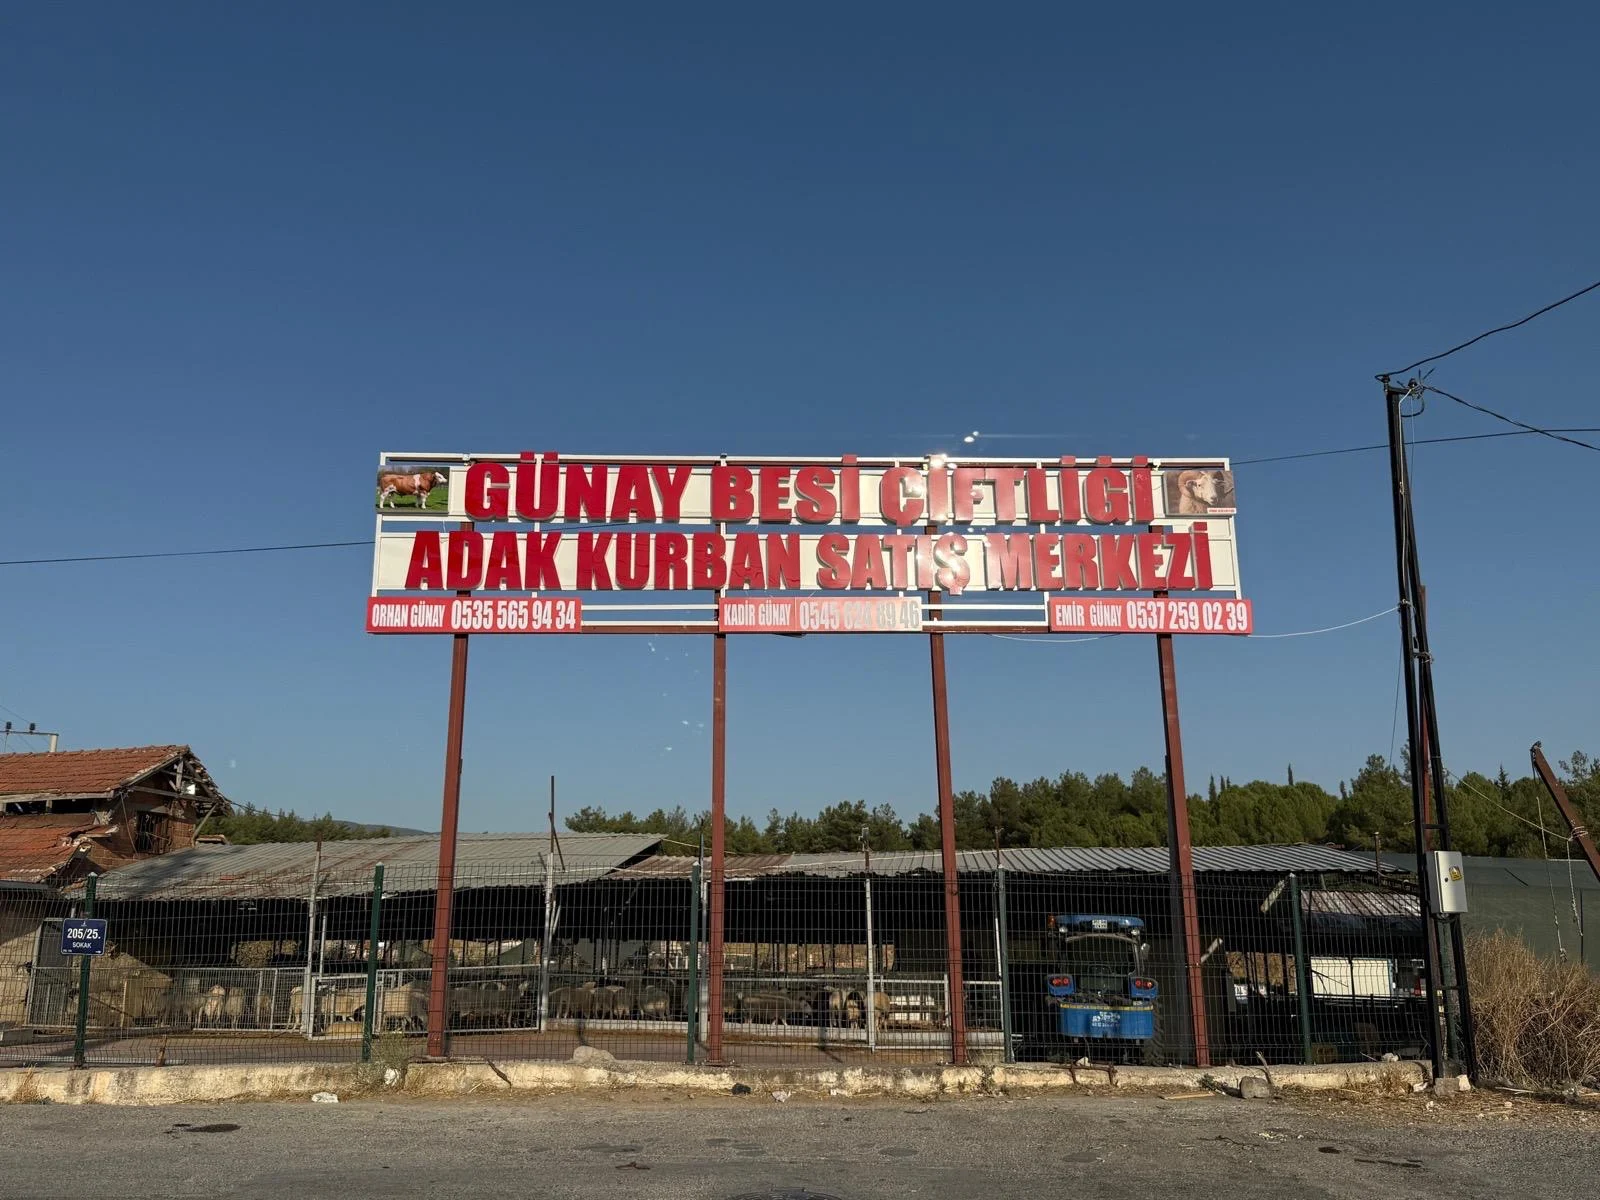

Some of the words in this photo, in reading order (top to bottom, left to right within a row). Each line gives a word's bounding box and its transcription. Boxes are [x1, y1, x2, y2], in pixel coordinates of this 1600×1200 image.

[464, 451, 693, 522] GÜNAY
[711, 453, 860, 524] BESİ
[405, 530, 562, 589] ADAK
[576, 531, 801, 590] KURBAN
[817, 532, 970, 596] SATIŞ
[984, 522, 1214, 591] MERKEZİ
[371, 603, 408, 627] ORHAN
[410, 601, 446, 628] GÜNAY
[451, 599, 494, 630] 0535
[496, 600, 529, 630] 565
[531, 600, 553, 630] 94
[555, 600, 576, 630] 34
[723, 600, 756, 626] KADİR
[758, 600, 792, 626] GÜNAY
[799, 601, 840, 630] 0545
[899, 600, 920, 629] 46
[1055, 601, 1085, 626] EMİR
[1089, 601, 1122, 627] GÜNAY
[1126, 601, 1167, 630] 0537
[1168, 601, 1200, 630] 259
[1202, 602, 1224, 631] 02
[1226, 602, 1248, 631] 39
[67, 928, 101, 939] 205/25.
